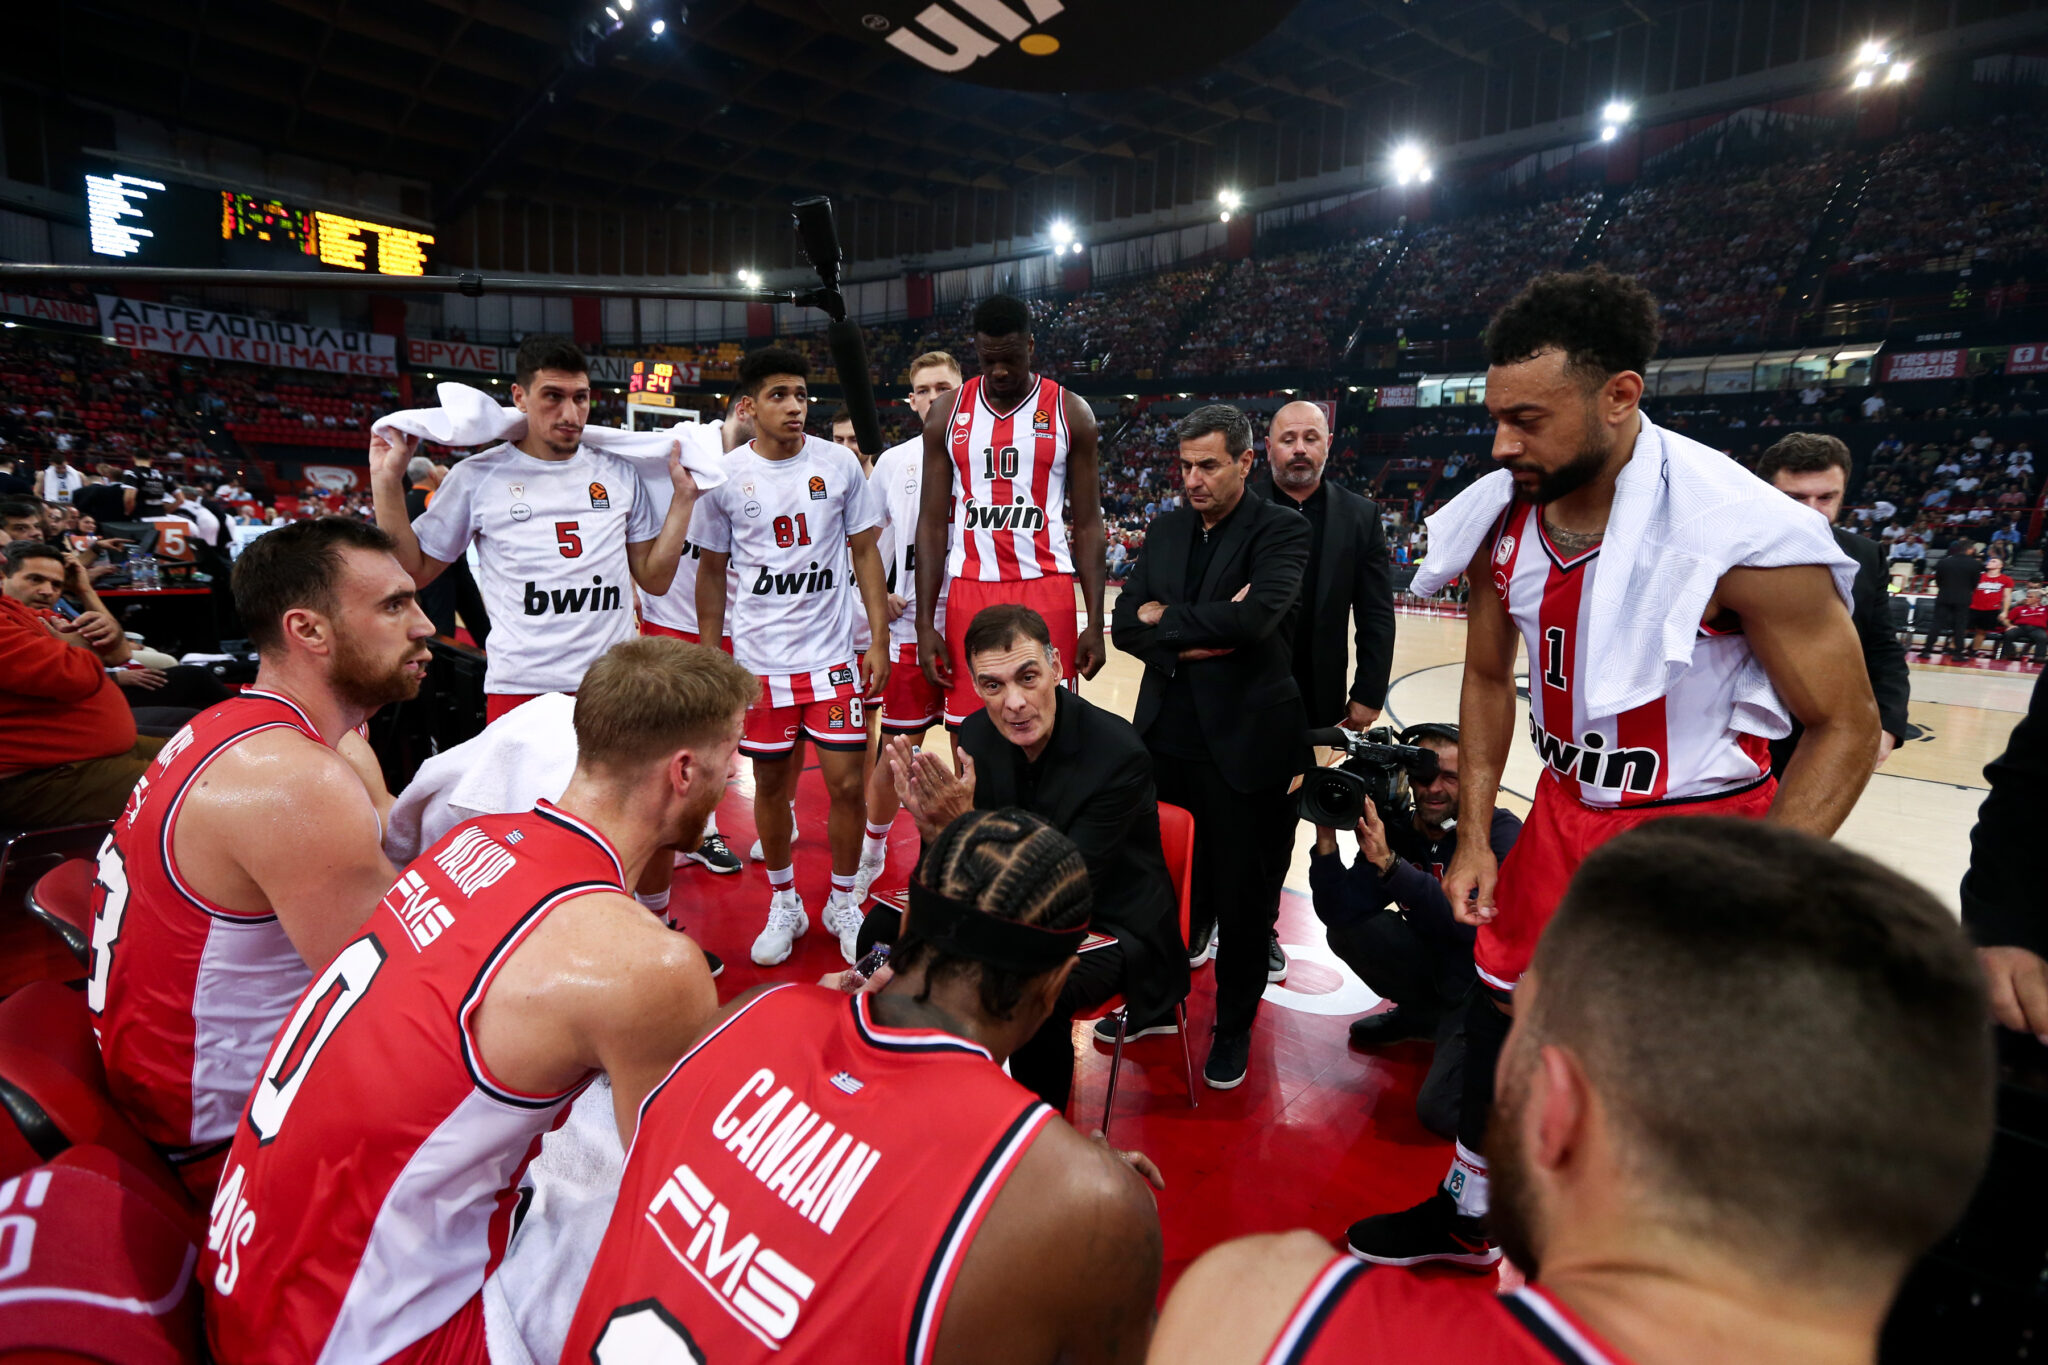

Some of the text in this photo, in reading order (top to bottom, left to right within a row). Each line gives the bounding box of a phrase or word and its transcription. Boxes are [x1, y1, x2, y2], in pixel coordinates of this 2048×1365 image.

[1888, 364, 1956, 381] PIRAEUS
[1893, 350, 1959, 367] THIS IS
[646, 373, 670, 393] 24
[983, 447, 1019, 480] 10
[773, 512, 812, 549] 81
[964, 496, 1044, 531] bwin
[164, 528, 186, 556] 5
[555, 521, 583, 559] 5
[524, 575, 621, 616] bwin
[752, 561, 834, 595] bwin
[1545, 626, 1567, 692] 1
[433, 825, 517, 899] WALKUP
[386, 869, 456, 948] FMS
[247, 931, 387, 1148] 0
[712, 1068, 881, 1235] CANAAN
[647, 1164, 816, 1341] FMS
